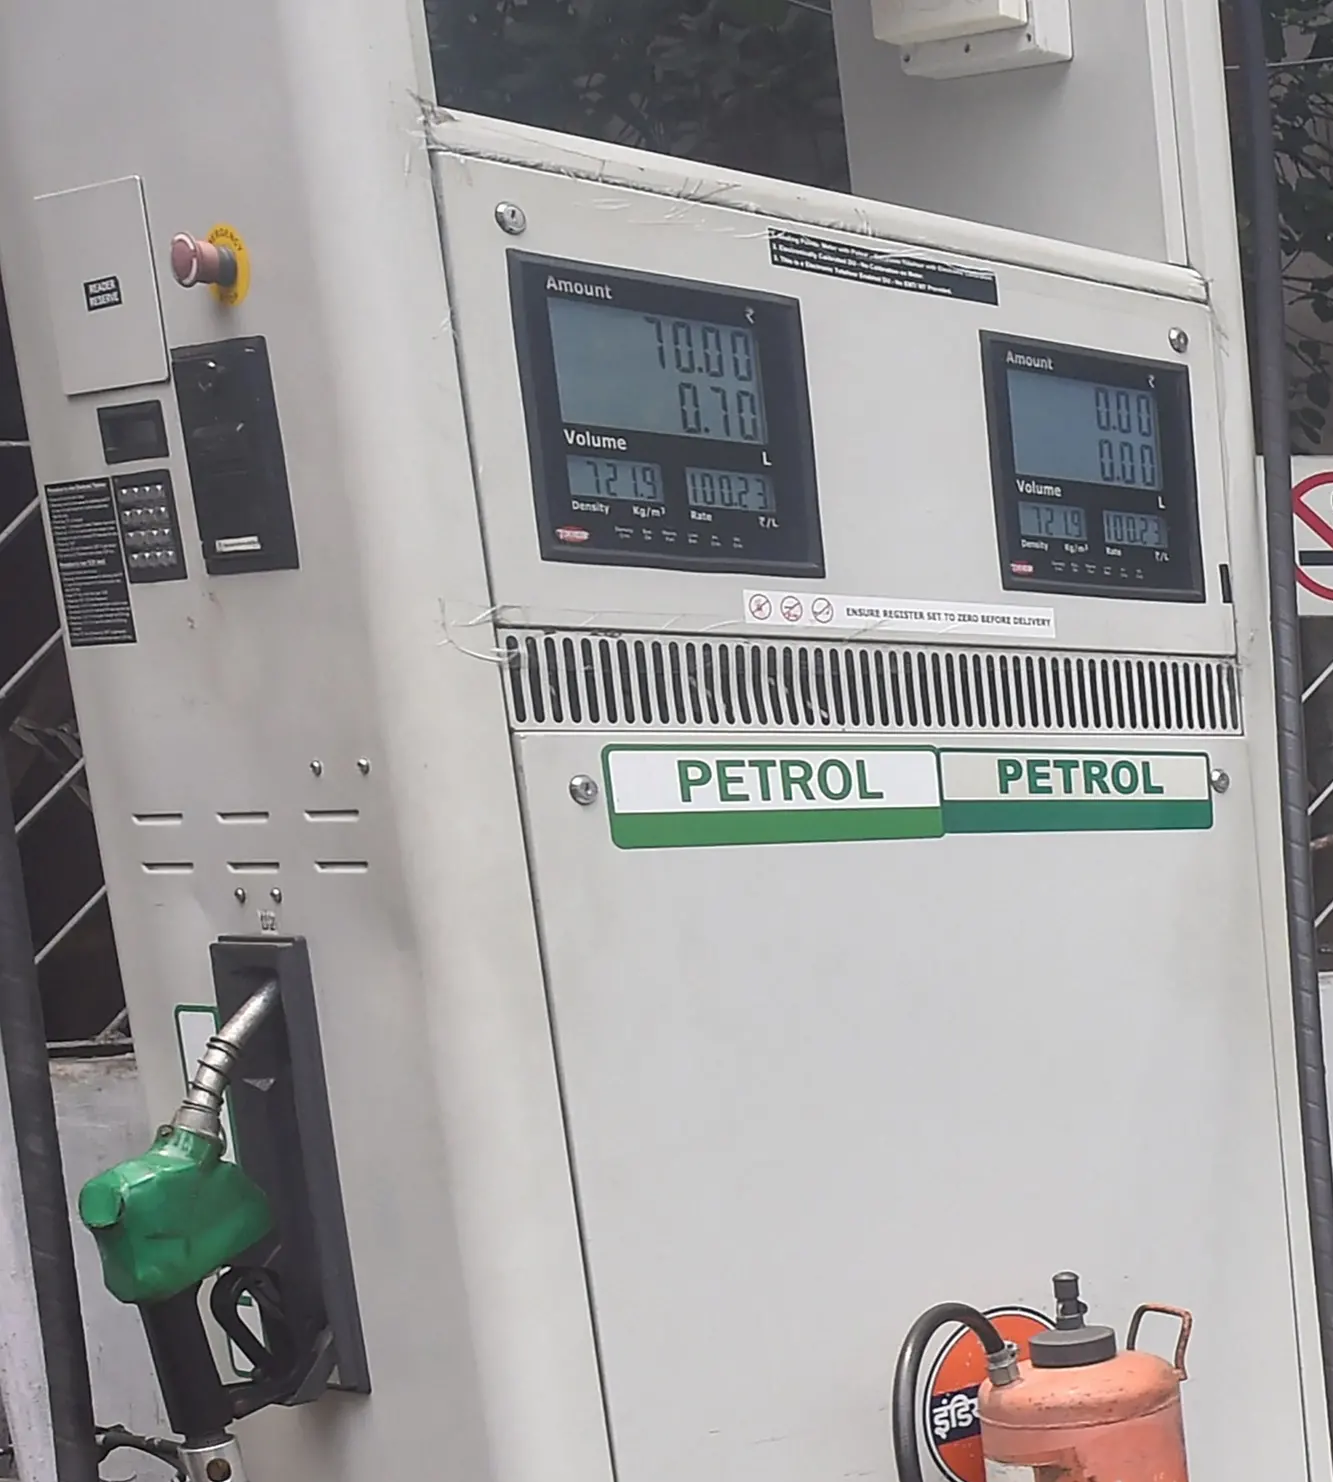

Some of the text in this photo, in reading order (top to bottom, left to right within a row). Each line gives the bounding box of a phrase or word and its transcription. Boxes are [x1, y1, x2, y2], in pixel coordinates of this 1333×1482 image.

[546, 275, 613, 300] Amount
[644, 315, 752, 382] 70.00
[1006, 350, 1054, 370] Amount
[678, 382, 758, 441] 0.70
[1095, 386, 1153, 438] 0.00
[563, 428, 628, 451] Volume
[762, 452, 772, 466] L
[1099, 438, 1157, 487] 0.00
[1016, 479, 1062, 497] Volume
[572, 499, 610, 515] Density
[1158, 496, 1165, 509] L
[690, 509, 713, 522] Rate
[846, 607, 881, 619] ENSURE
[882, 609, 926, 621] REGISTER
[926, 612, 942, 622] SET
[942, 614, 955, 622] TO
[957, 615, 979, 623] ZERO
[1012, 618, 1051, 627] DELIVERY
[677, 759, 884, 803] PETROL
[998, 758, 1164, 796] PETROL
